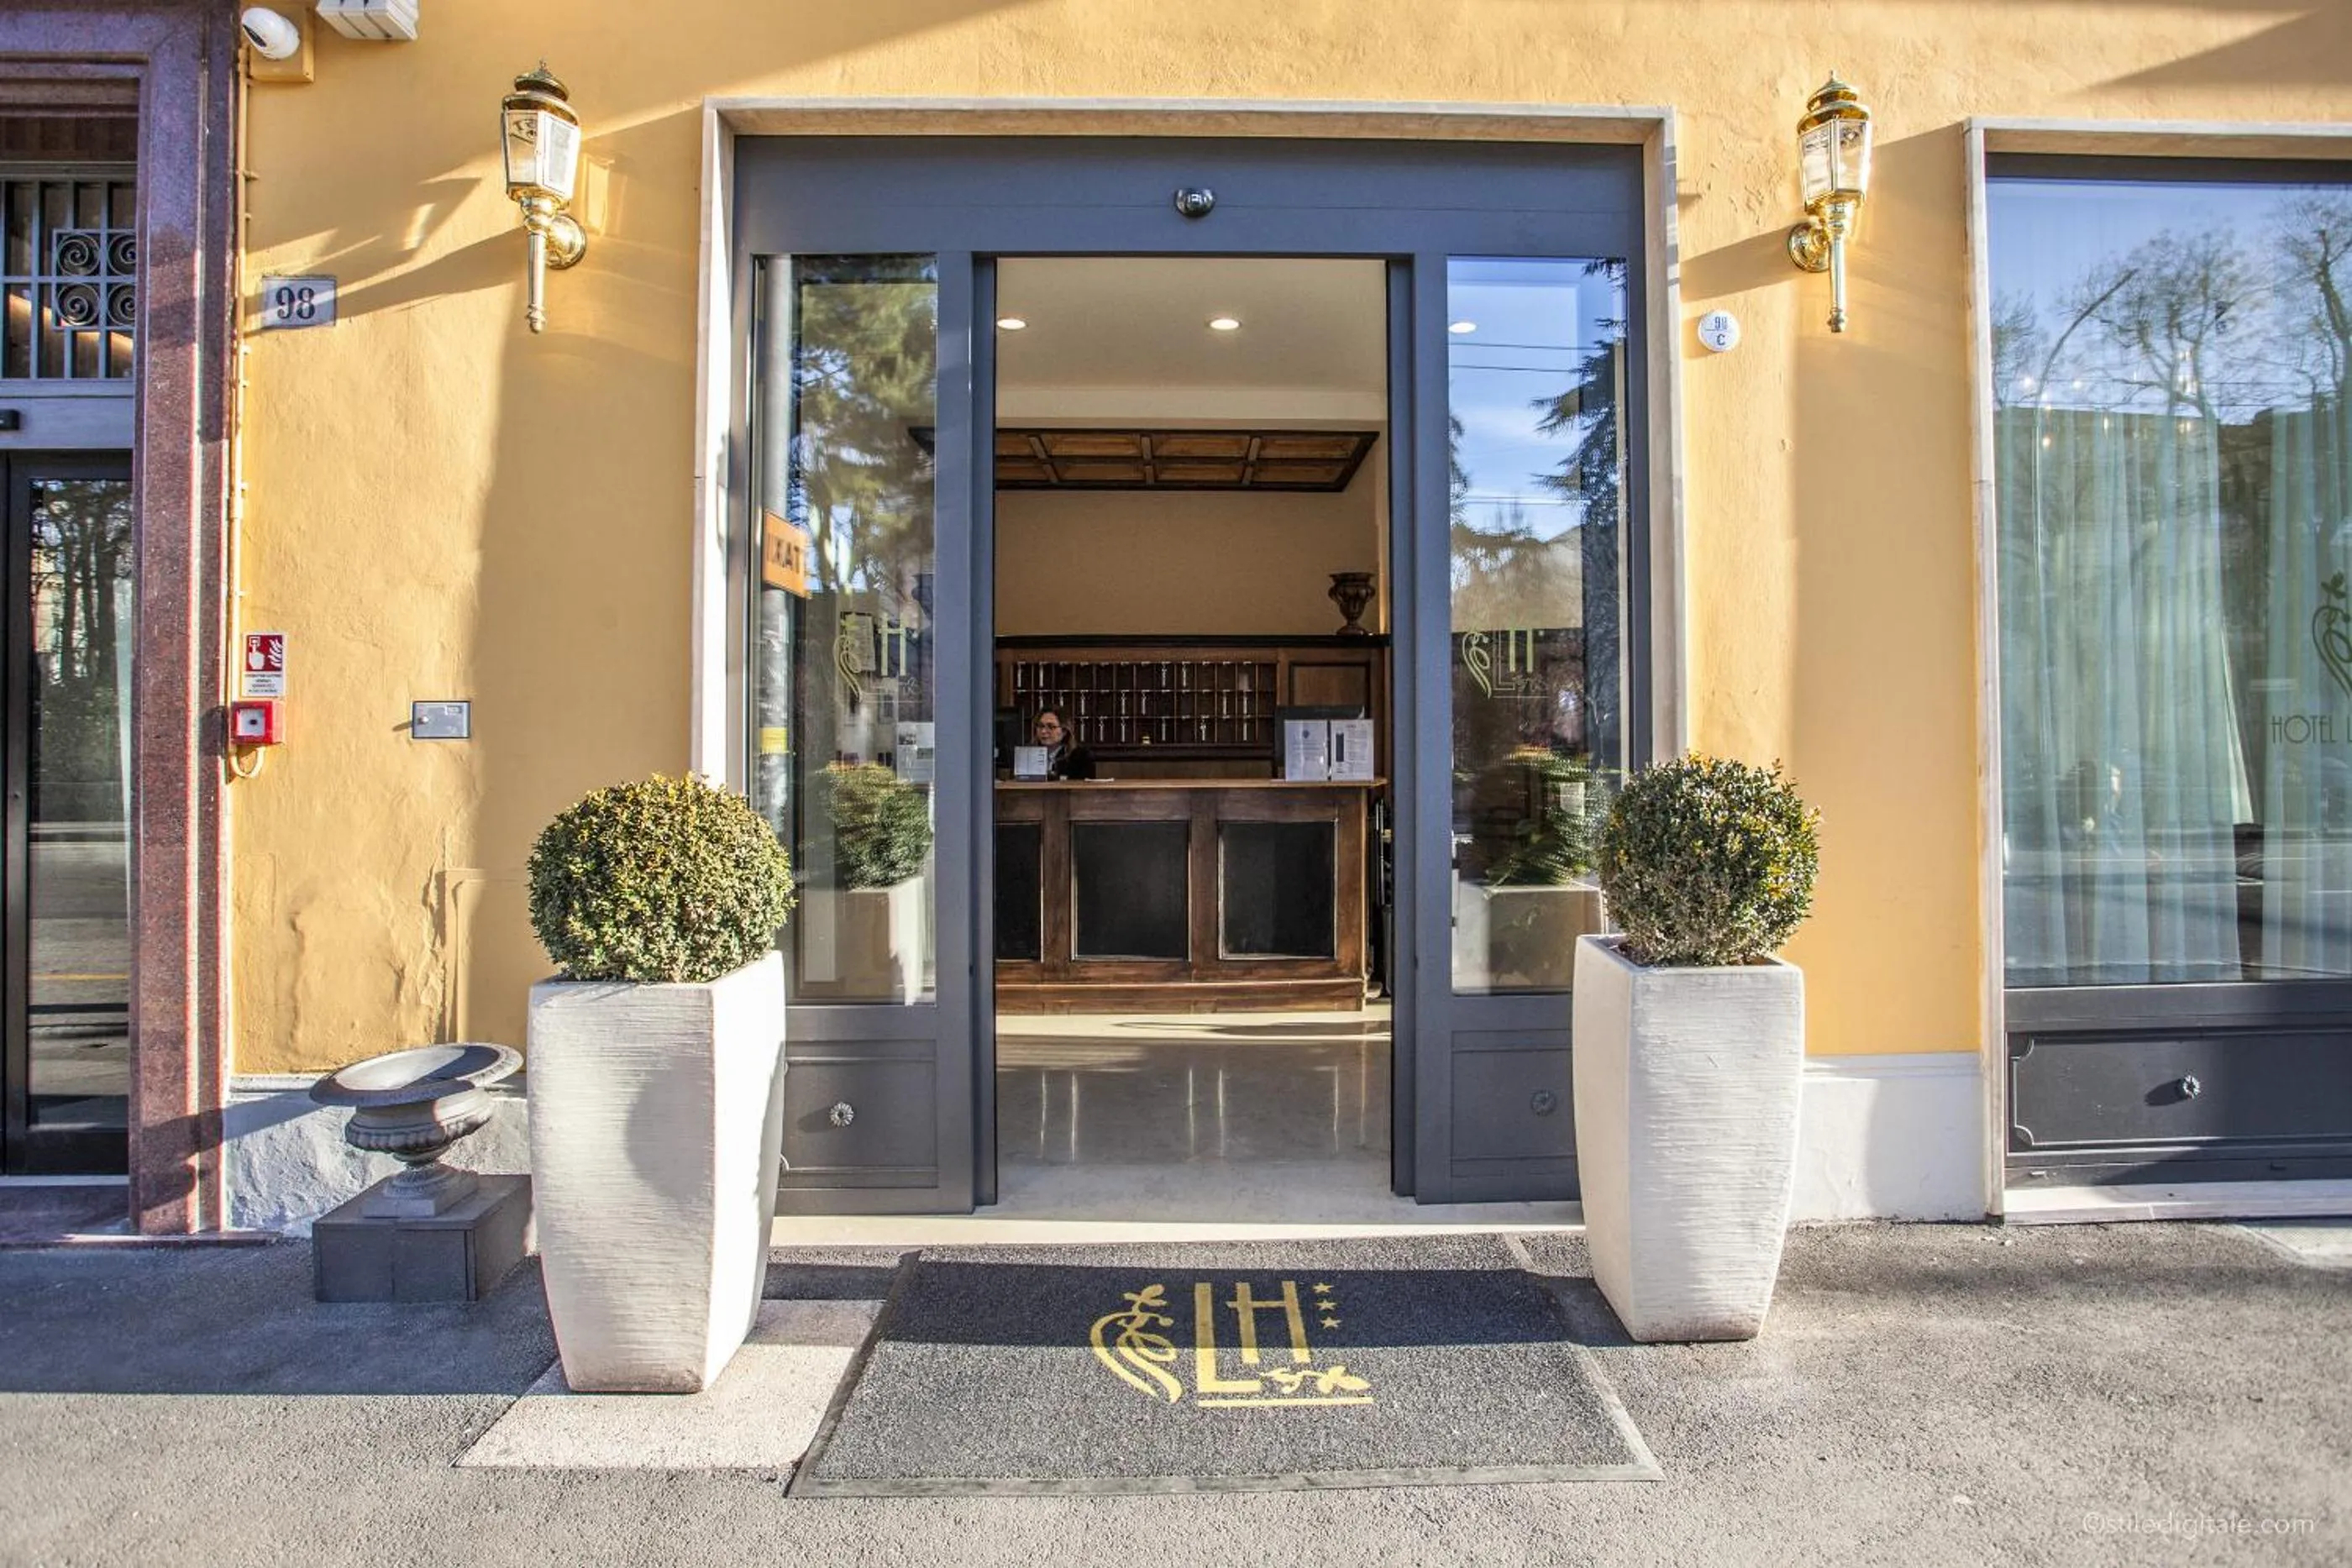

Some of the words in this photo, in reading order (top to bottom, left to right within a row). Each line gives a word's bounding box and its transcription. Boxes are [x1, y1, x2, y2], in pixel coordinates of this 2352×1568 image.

[275, 286, 316, 319] 98
[1716, 333, 1725, 346] C
[2270, 715, 2337, 744] HOTEL
